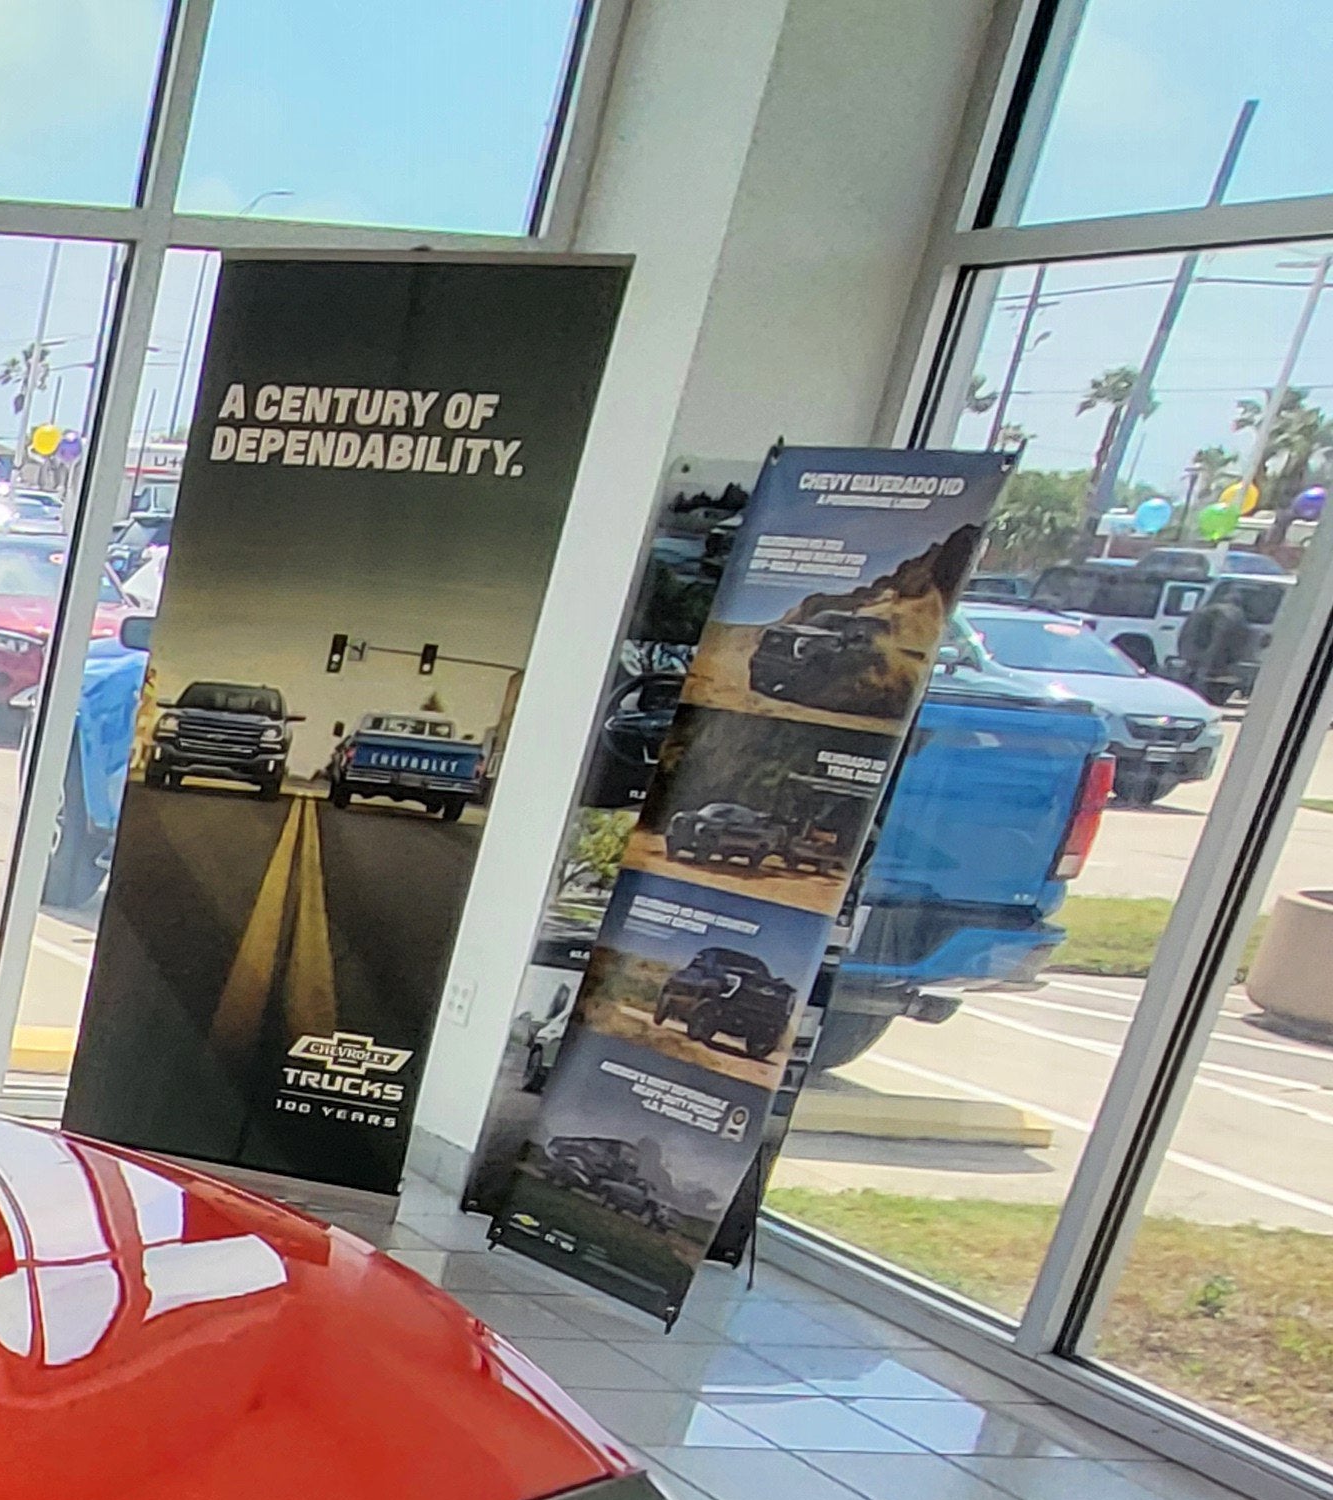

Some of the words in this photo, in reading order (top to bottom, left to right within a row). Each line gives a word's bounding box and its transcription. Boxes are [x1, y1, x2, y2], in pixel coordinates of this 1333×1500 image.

[218, 383, 245, 419] A
[254, 386, 439, 428] CENTURY
[443, 392, 500, 430] OF
[209, 426, 524, 478] DEPENDABILITY.
[798, 472, 851, 491] CHEVY
[850, 474, 938, 495] SILVERADO
[937, 477, 965, 496] HD
[370, 752, 459, 773] CHEVROLET
[309, 1041, 391, 1065] CHEVROLET
[282, 1066, 405, 1102] TRUCKS
[276, 1098, 312, 1114] 100
[321, 1105, 397, 1129] YEARS
